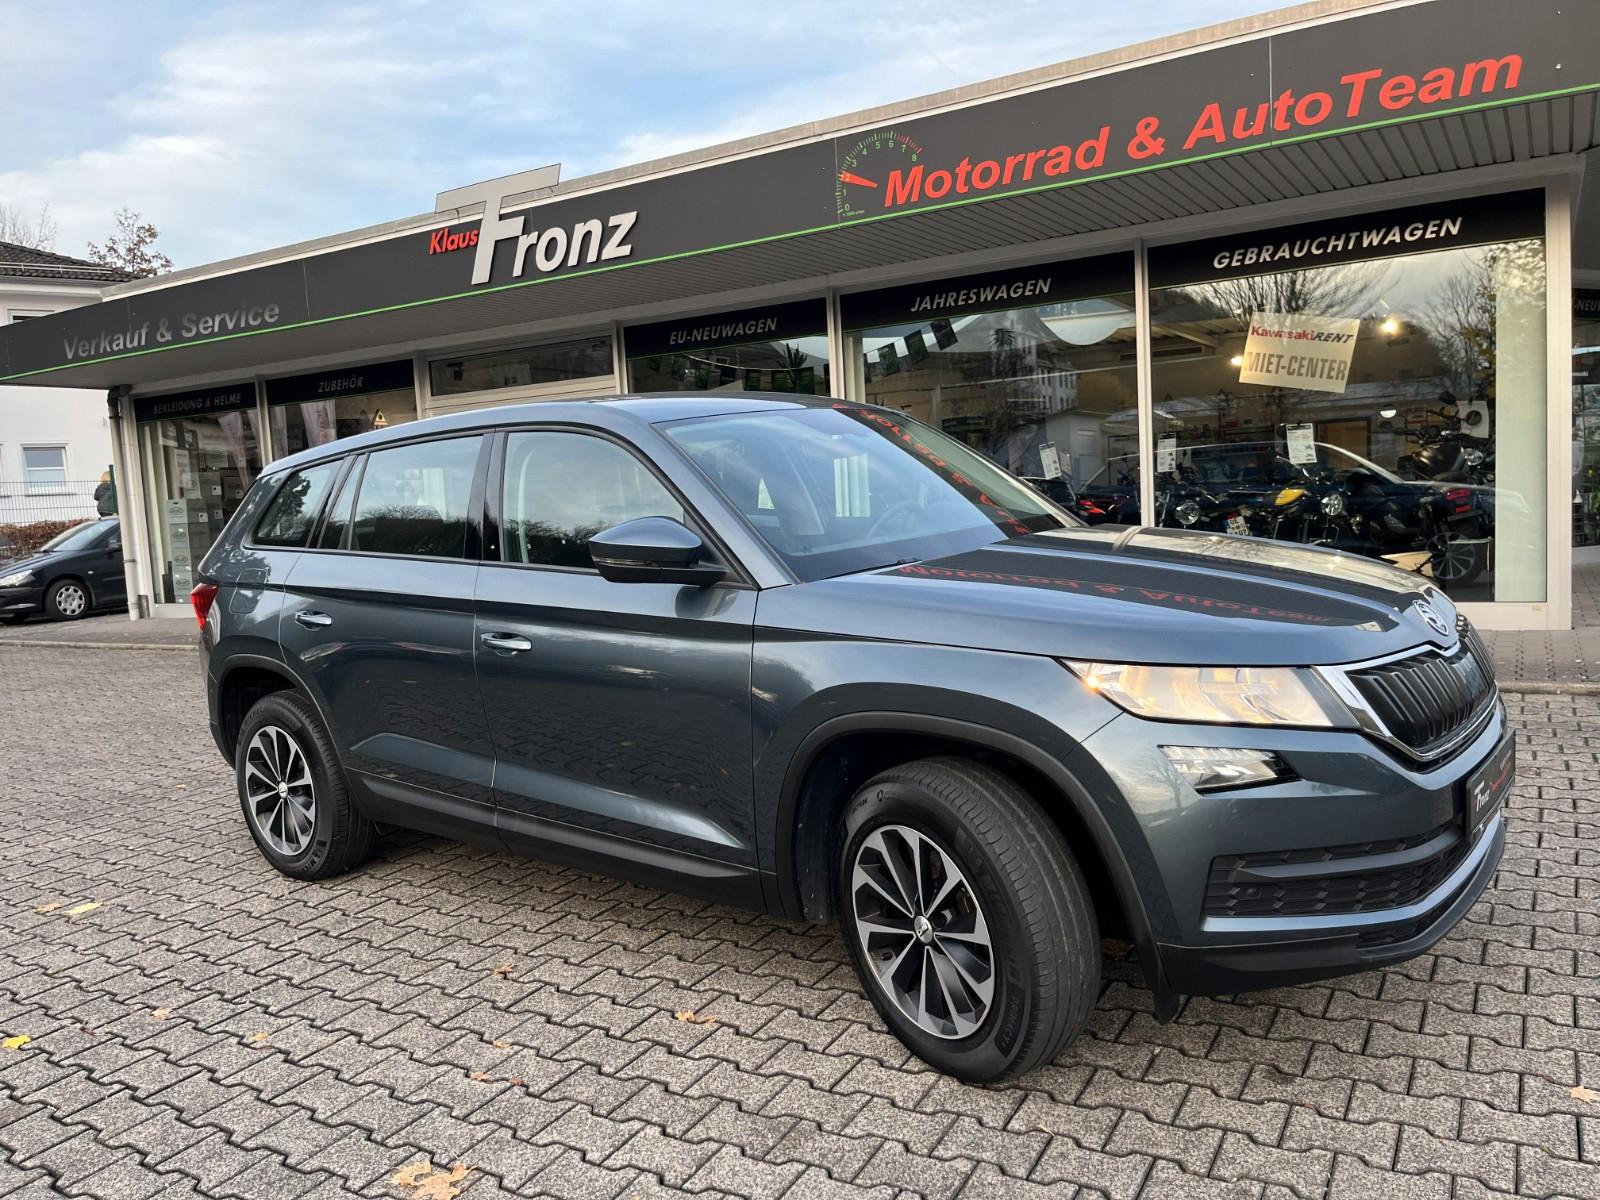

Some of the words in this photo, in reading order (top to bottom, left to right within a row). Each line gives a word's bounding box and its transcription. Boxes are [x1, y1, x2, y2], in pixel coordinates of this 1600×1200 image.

[884, 126, 1110, 207] Motorrad
[1126, 116, 1165, 159] &
[434, 163, 638, 286] Fronz
[429, 228, 480, 255] Klaus
[1212, 216, 1463, 270] GEBRAUCHTWAGEN
[910, 277, 1052, 312] JAHRESWAGEN
[63, 321, 150, 360] Verkauf
[156, 318, 173, 343] &
[181, 303, 280, 338] Service
[669, 317, 778, 345] EU-NEUWAGEN
[1244, 351, 1349, 381] MIET-CENTER
[318, 375, 364, 393] ZUBEHÖR
[153, 398, 203, 415] BEKLEIDUNG
[213, 393, 242, 407] HELME
